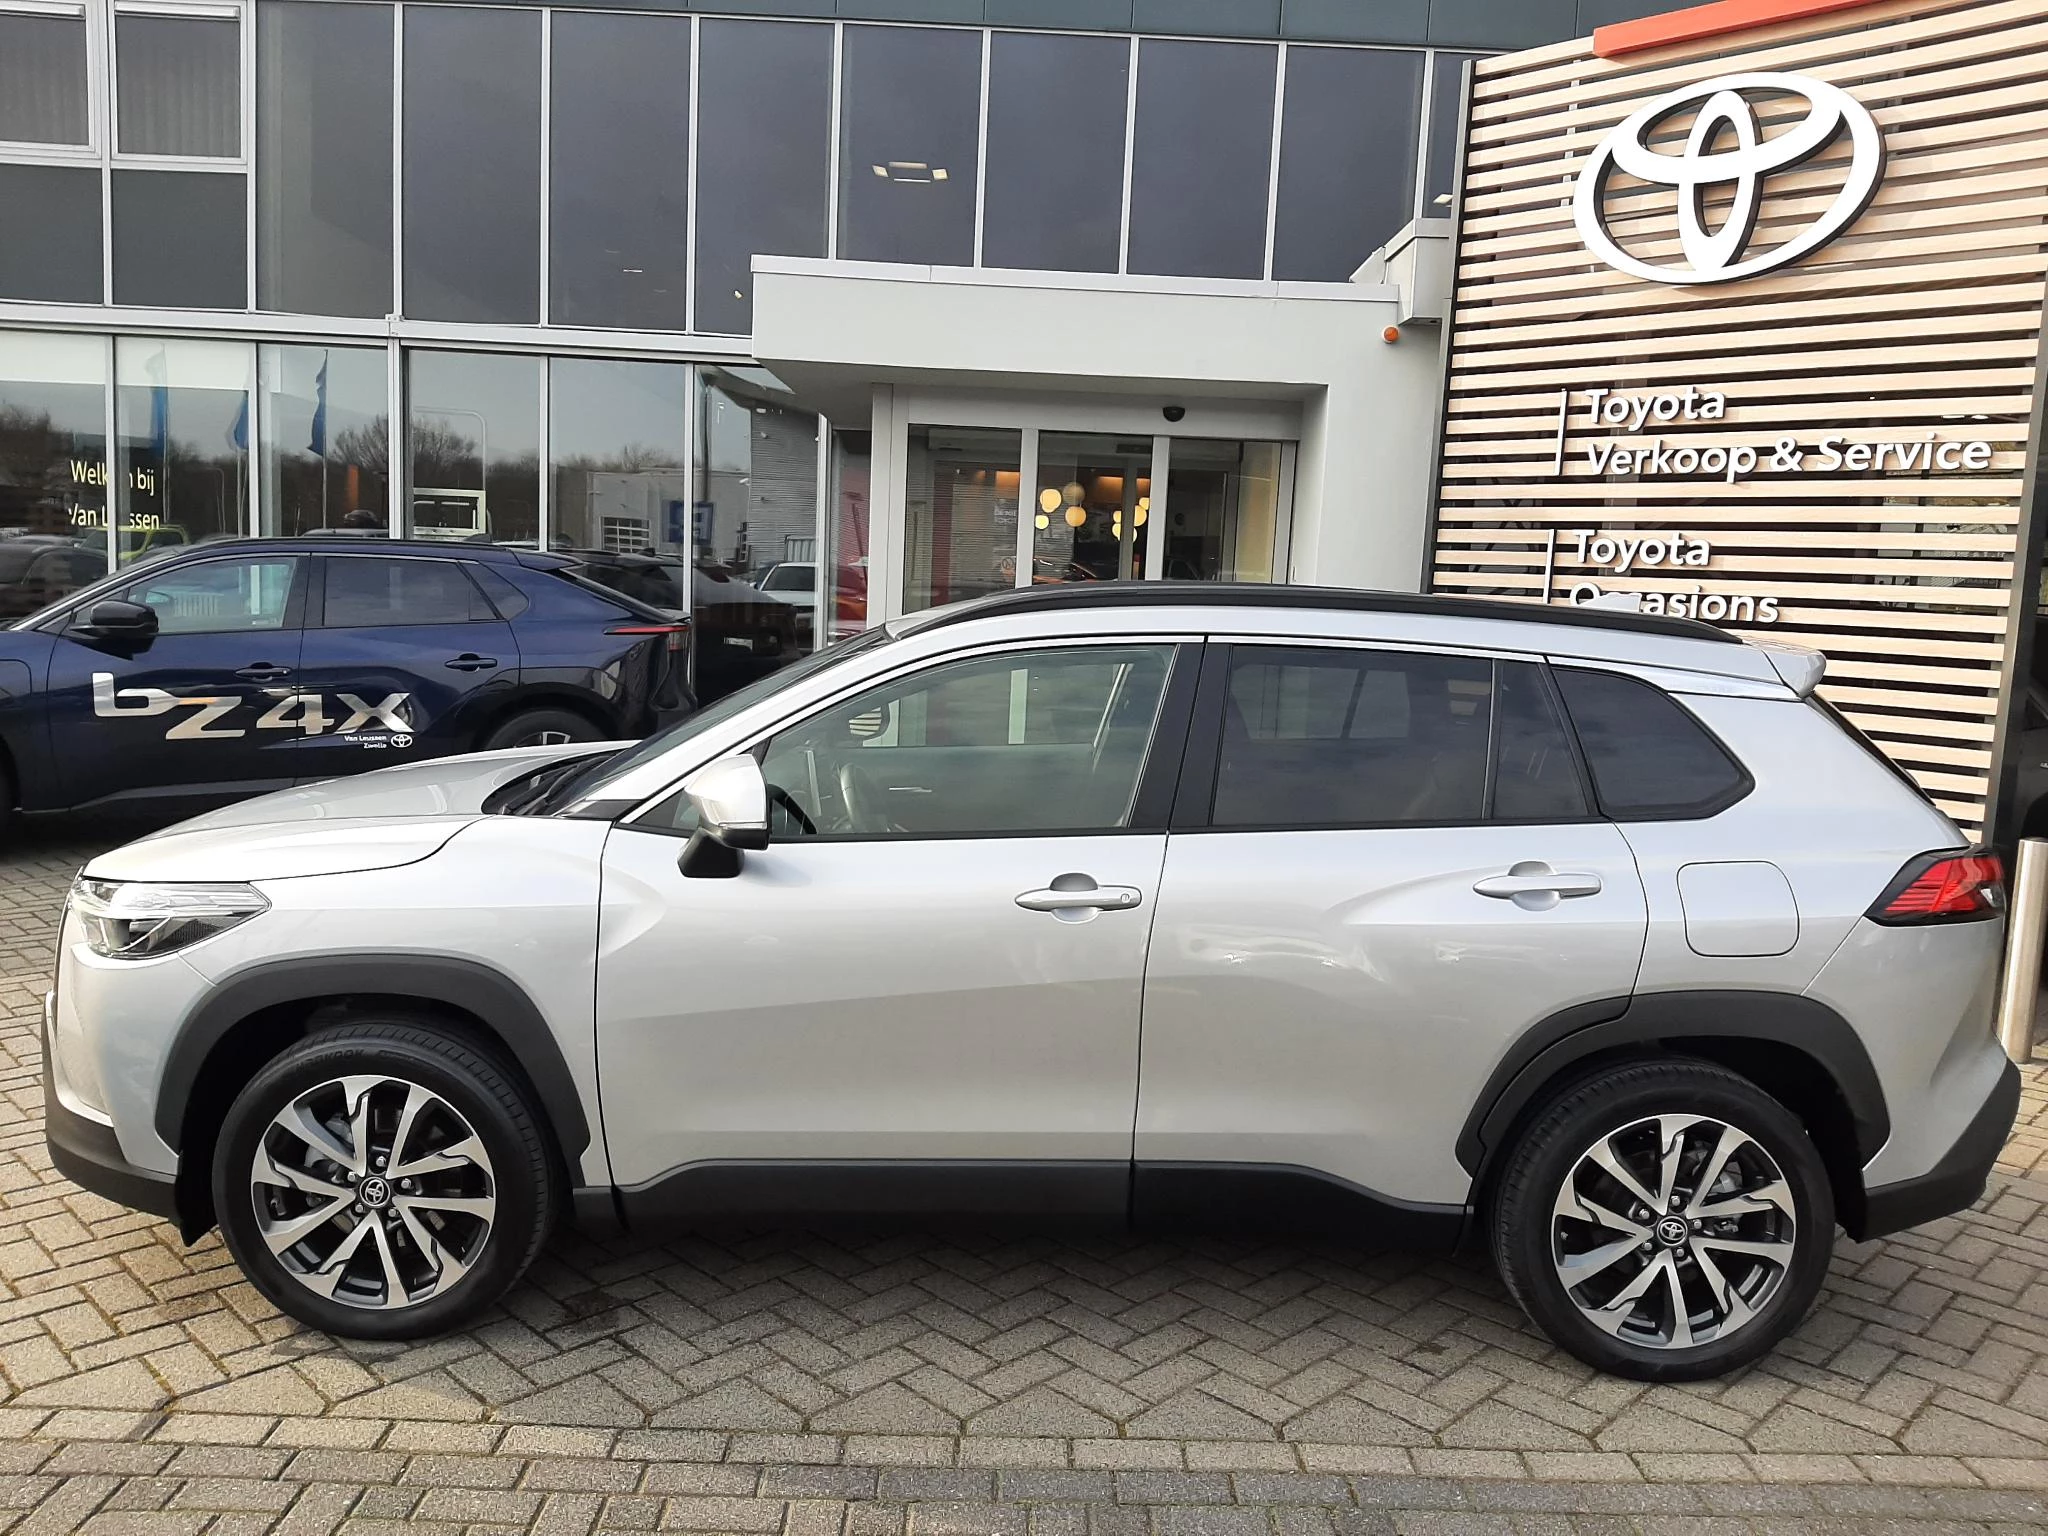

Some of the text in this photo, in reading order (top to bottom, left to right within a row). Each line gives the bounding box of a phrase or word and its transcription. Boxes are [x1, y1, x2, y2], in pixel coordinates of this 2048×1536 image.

[1585, 386, 1726, 431] Toyota
[1588, 431, 1993, 484] Verkoop & Service
[137, 466, 154, 496] bij
[68, 503, 160, 530] Van Lssen
[1573, 529, 1711, 573] Toyota
[1569, 581, 1780, 623] Oasions
